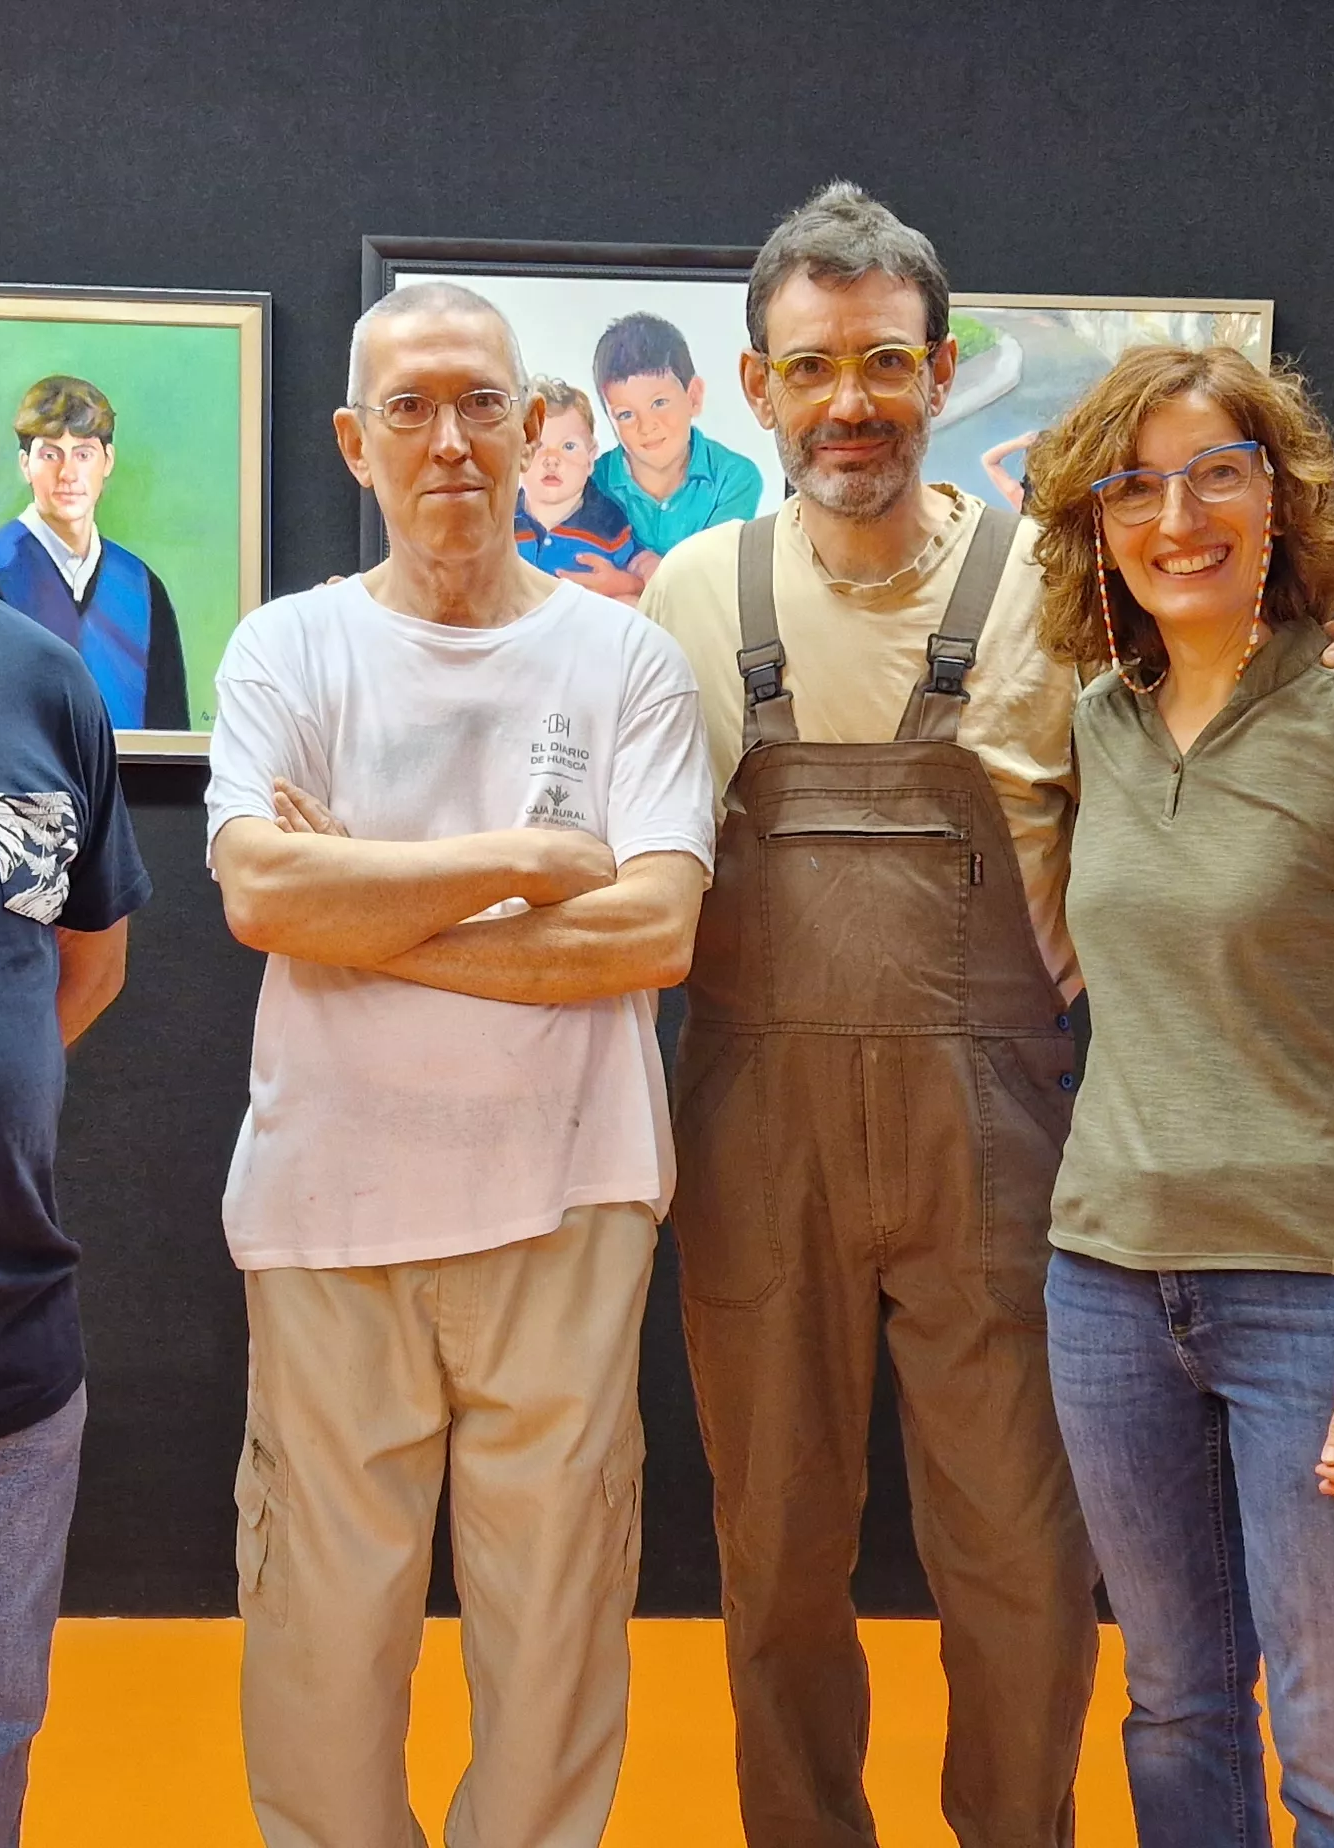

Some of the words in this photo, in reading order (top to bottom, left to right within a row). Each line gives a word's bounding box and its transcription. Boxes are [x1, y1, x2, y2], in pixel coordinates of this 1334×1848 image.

[531, 743, 547, 753] EL
[550, 741, 590, 760] DIARIO
[530, 755, 545, 765] DE
[547, 755, 588, 772] HUESCA
[525, 804, 549, 815] CAJA
[552, 807, 587, 821] RURAL
